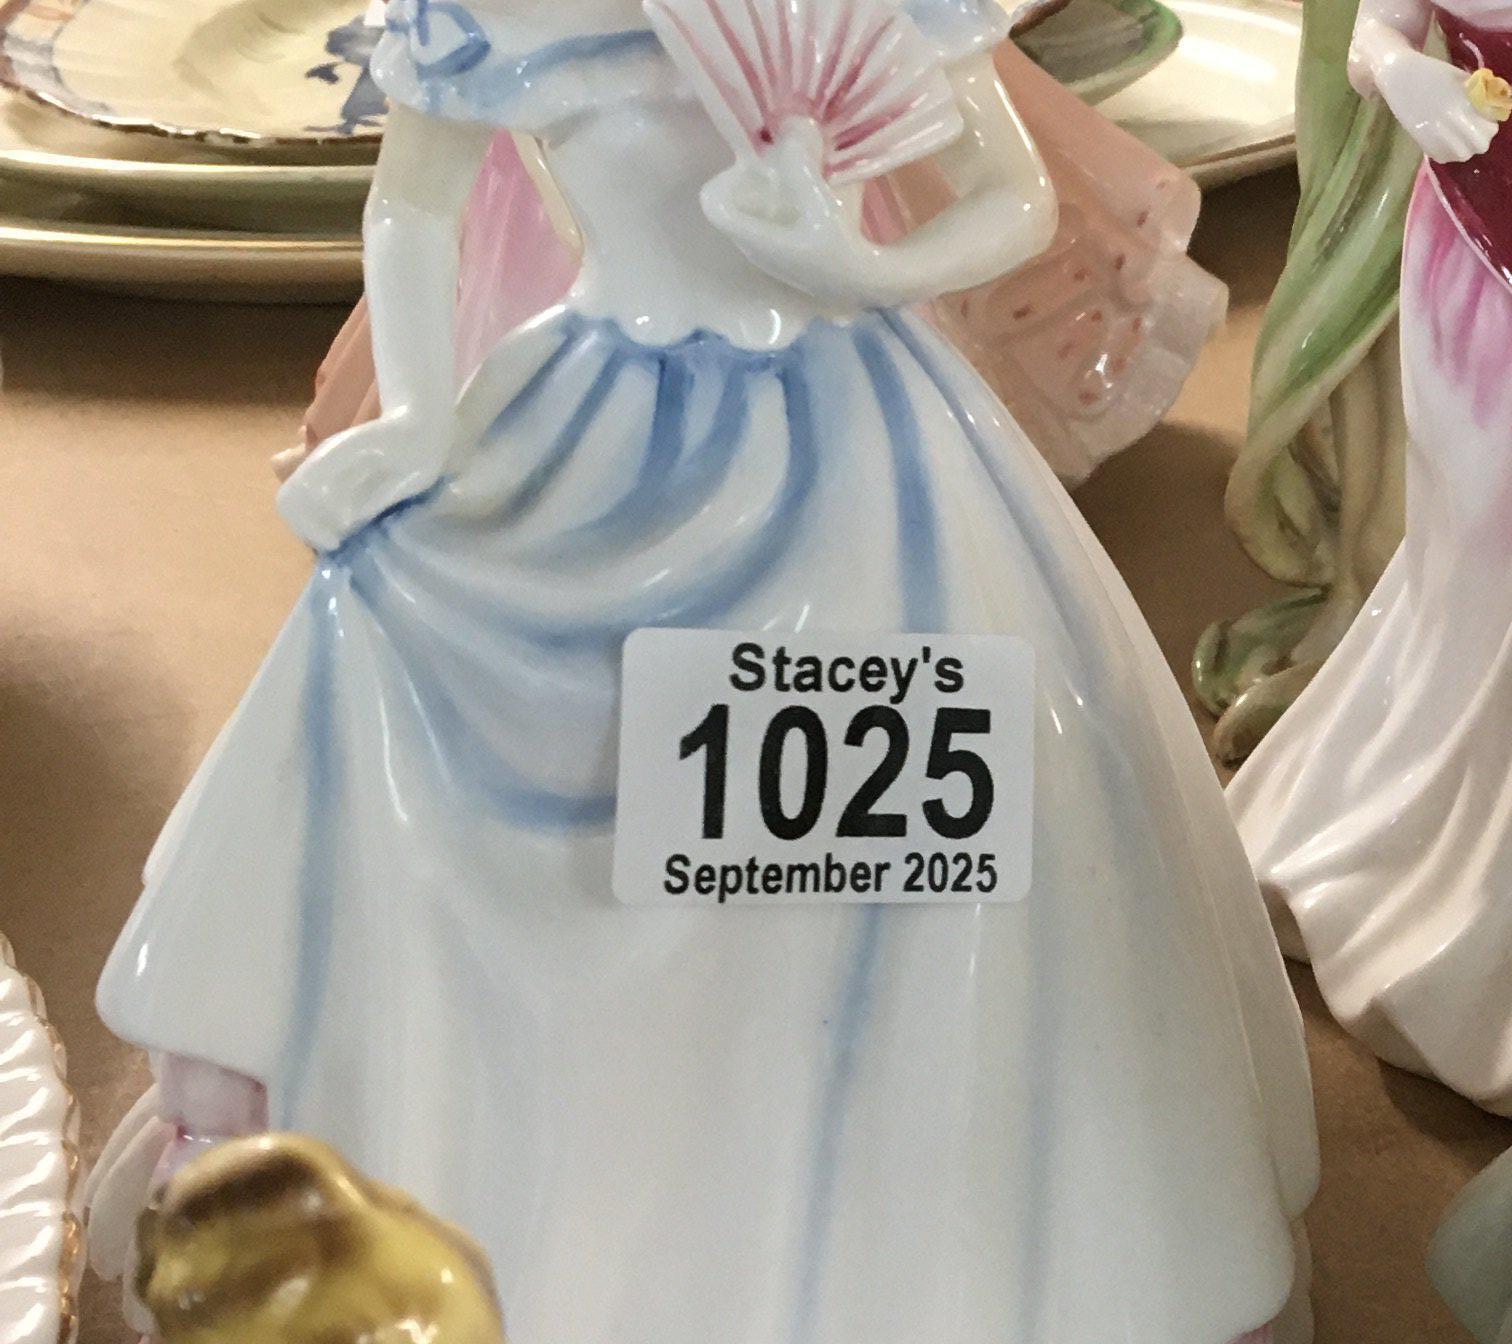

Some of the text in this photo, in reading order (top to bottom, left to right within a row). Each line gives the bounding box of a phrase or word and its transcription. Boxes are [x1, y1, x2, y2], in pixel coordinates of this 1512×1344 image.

[729, 642, 965, 704] Stacey's
[679, 703, 995, 840] 1025
[663, 852, 998, 903] September 2025
